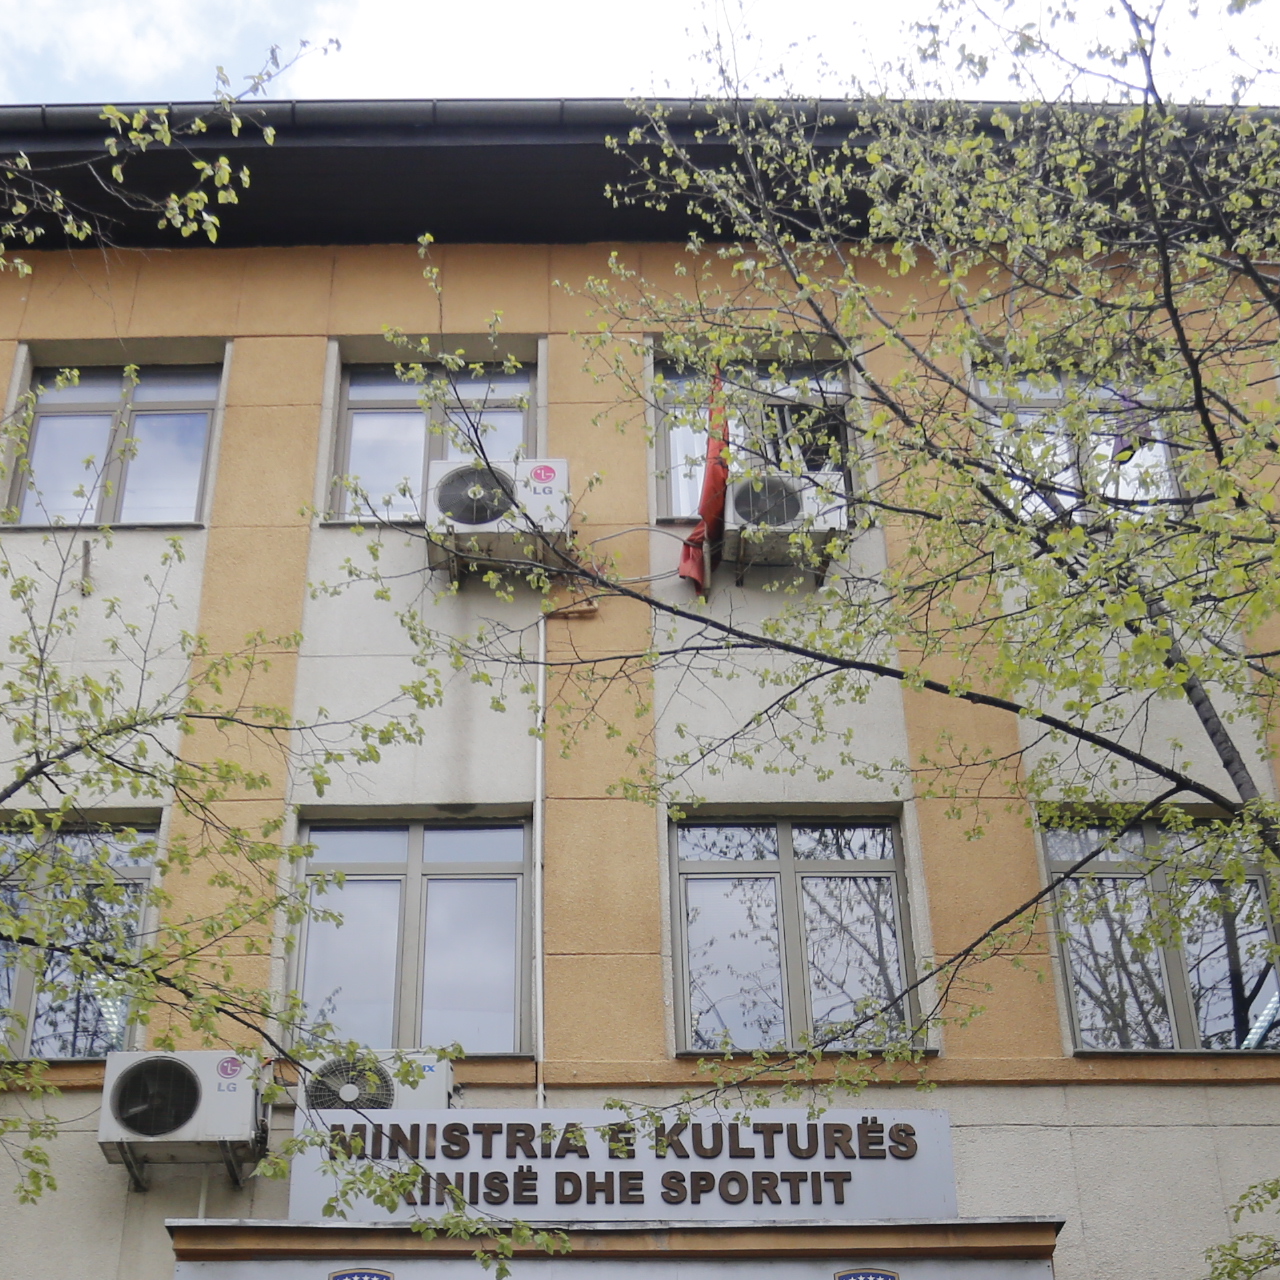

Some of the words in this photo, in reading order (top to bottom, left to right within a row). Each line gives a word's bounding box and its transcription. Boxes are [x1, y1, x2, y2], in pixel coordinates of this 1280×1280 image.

[533, 486, 553, 496] LG
[217, 1082, 237, 1093] LG
[329, 1122, 589, 1160] MINISTRIA
[608, 1123, 636, 1159] E
[655, 1116, 918, 1160] KULTURËS
[555, 1171, 644, 1205] DHE
[661, 1170, 852, 1205] SPORTIT
